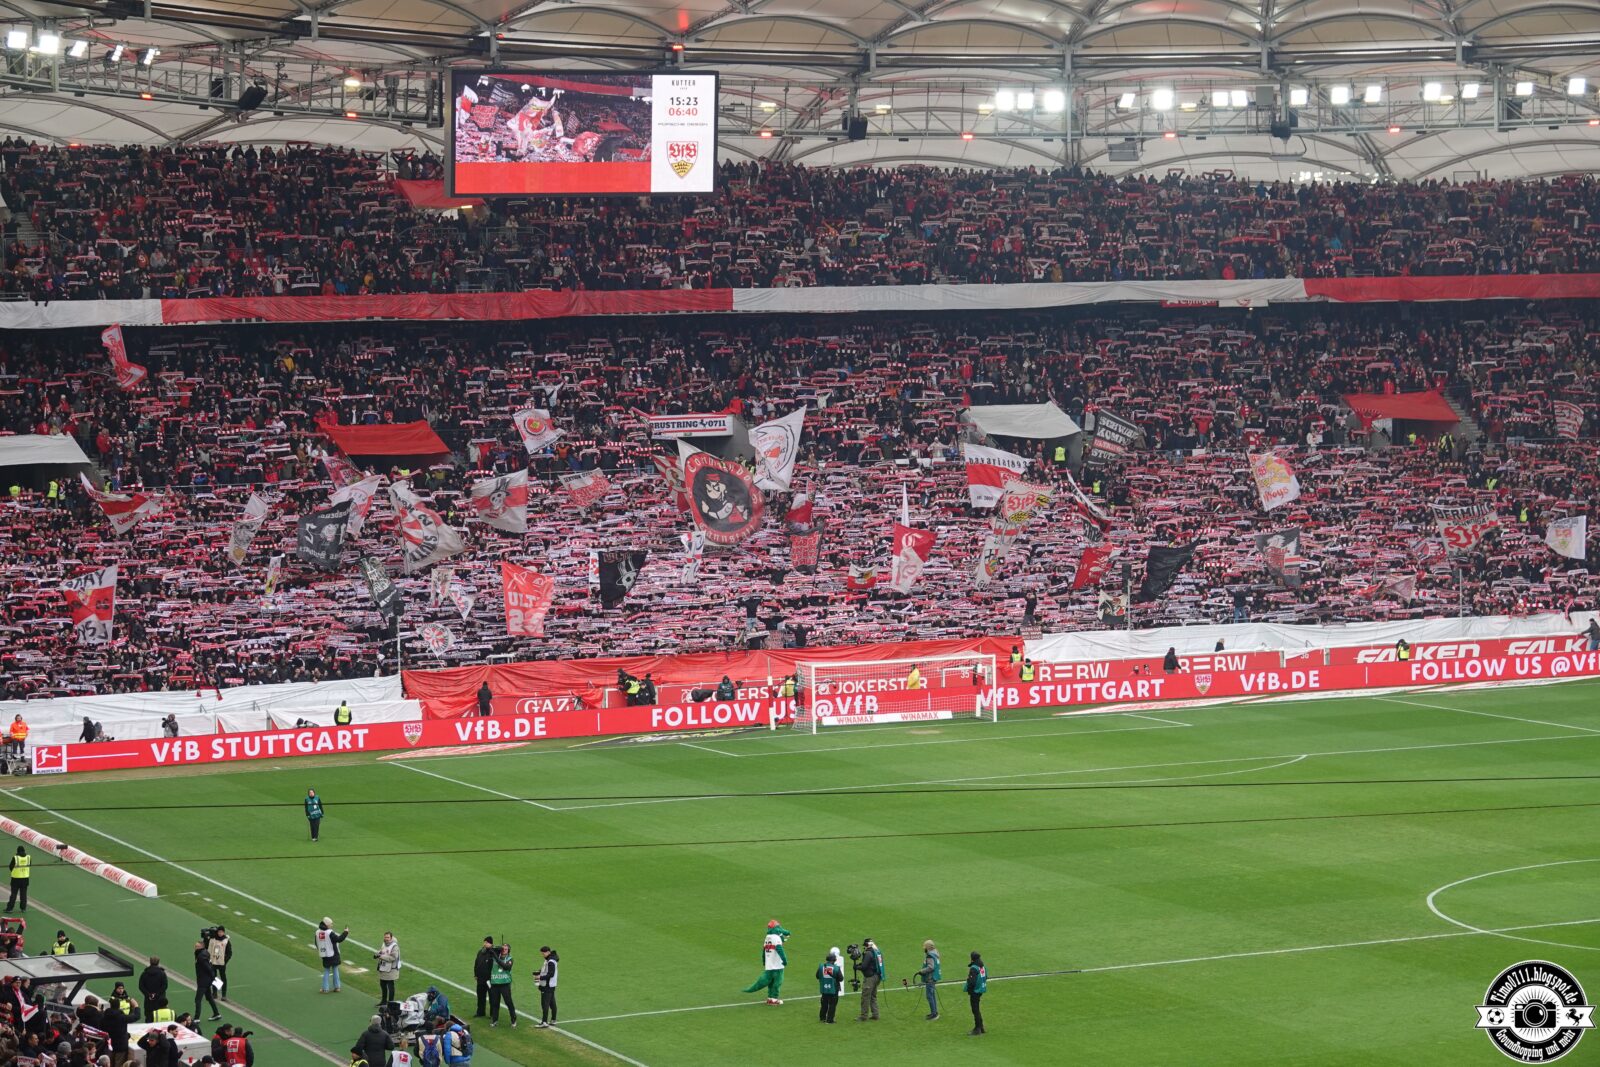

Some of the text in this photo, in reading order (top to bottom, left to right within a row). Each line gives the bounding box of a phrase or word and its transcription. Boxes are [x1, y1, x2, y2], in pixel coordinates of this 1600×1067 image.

[669, 107, 698, 116] 06:40
[670, 97, 698, 106] 15:23
[1411, 652, 1600, 681] FOLLOW US @Vf
[980, 678, 1165, 707] VfB STUTTGART
[1239, 670, 1320, 692] VfB.DE
[651, 701, 760, 727] FOLLOW
[815, 695, 878, 718] @VfB
[836, 715, 875, 724] WINAMAX
[900, 712, 939, 721] WINAMAX
[455, 716, 547, 741] VfB.DE
[150, 728, 369, 764] VfB STUTTGART
